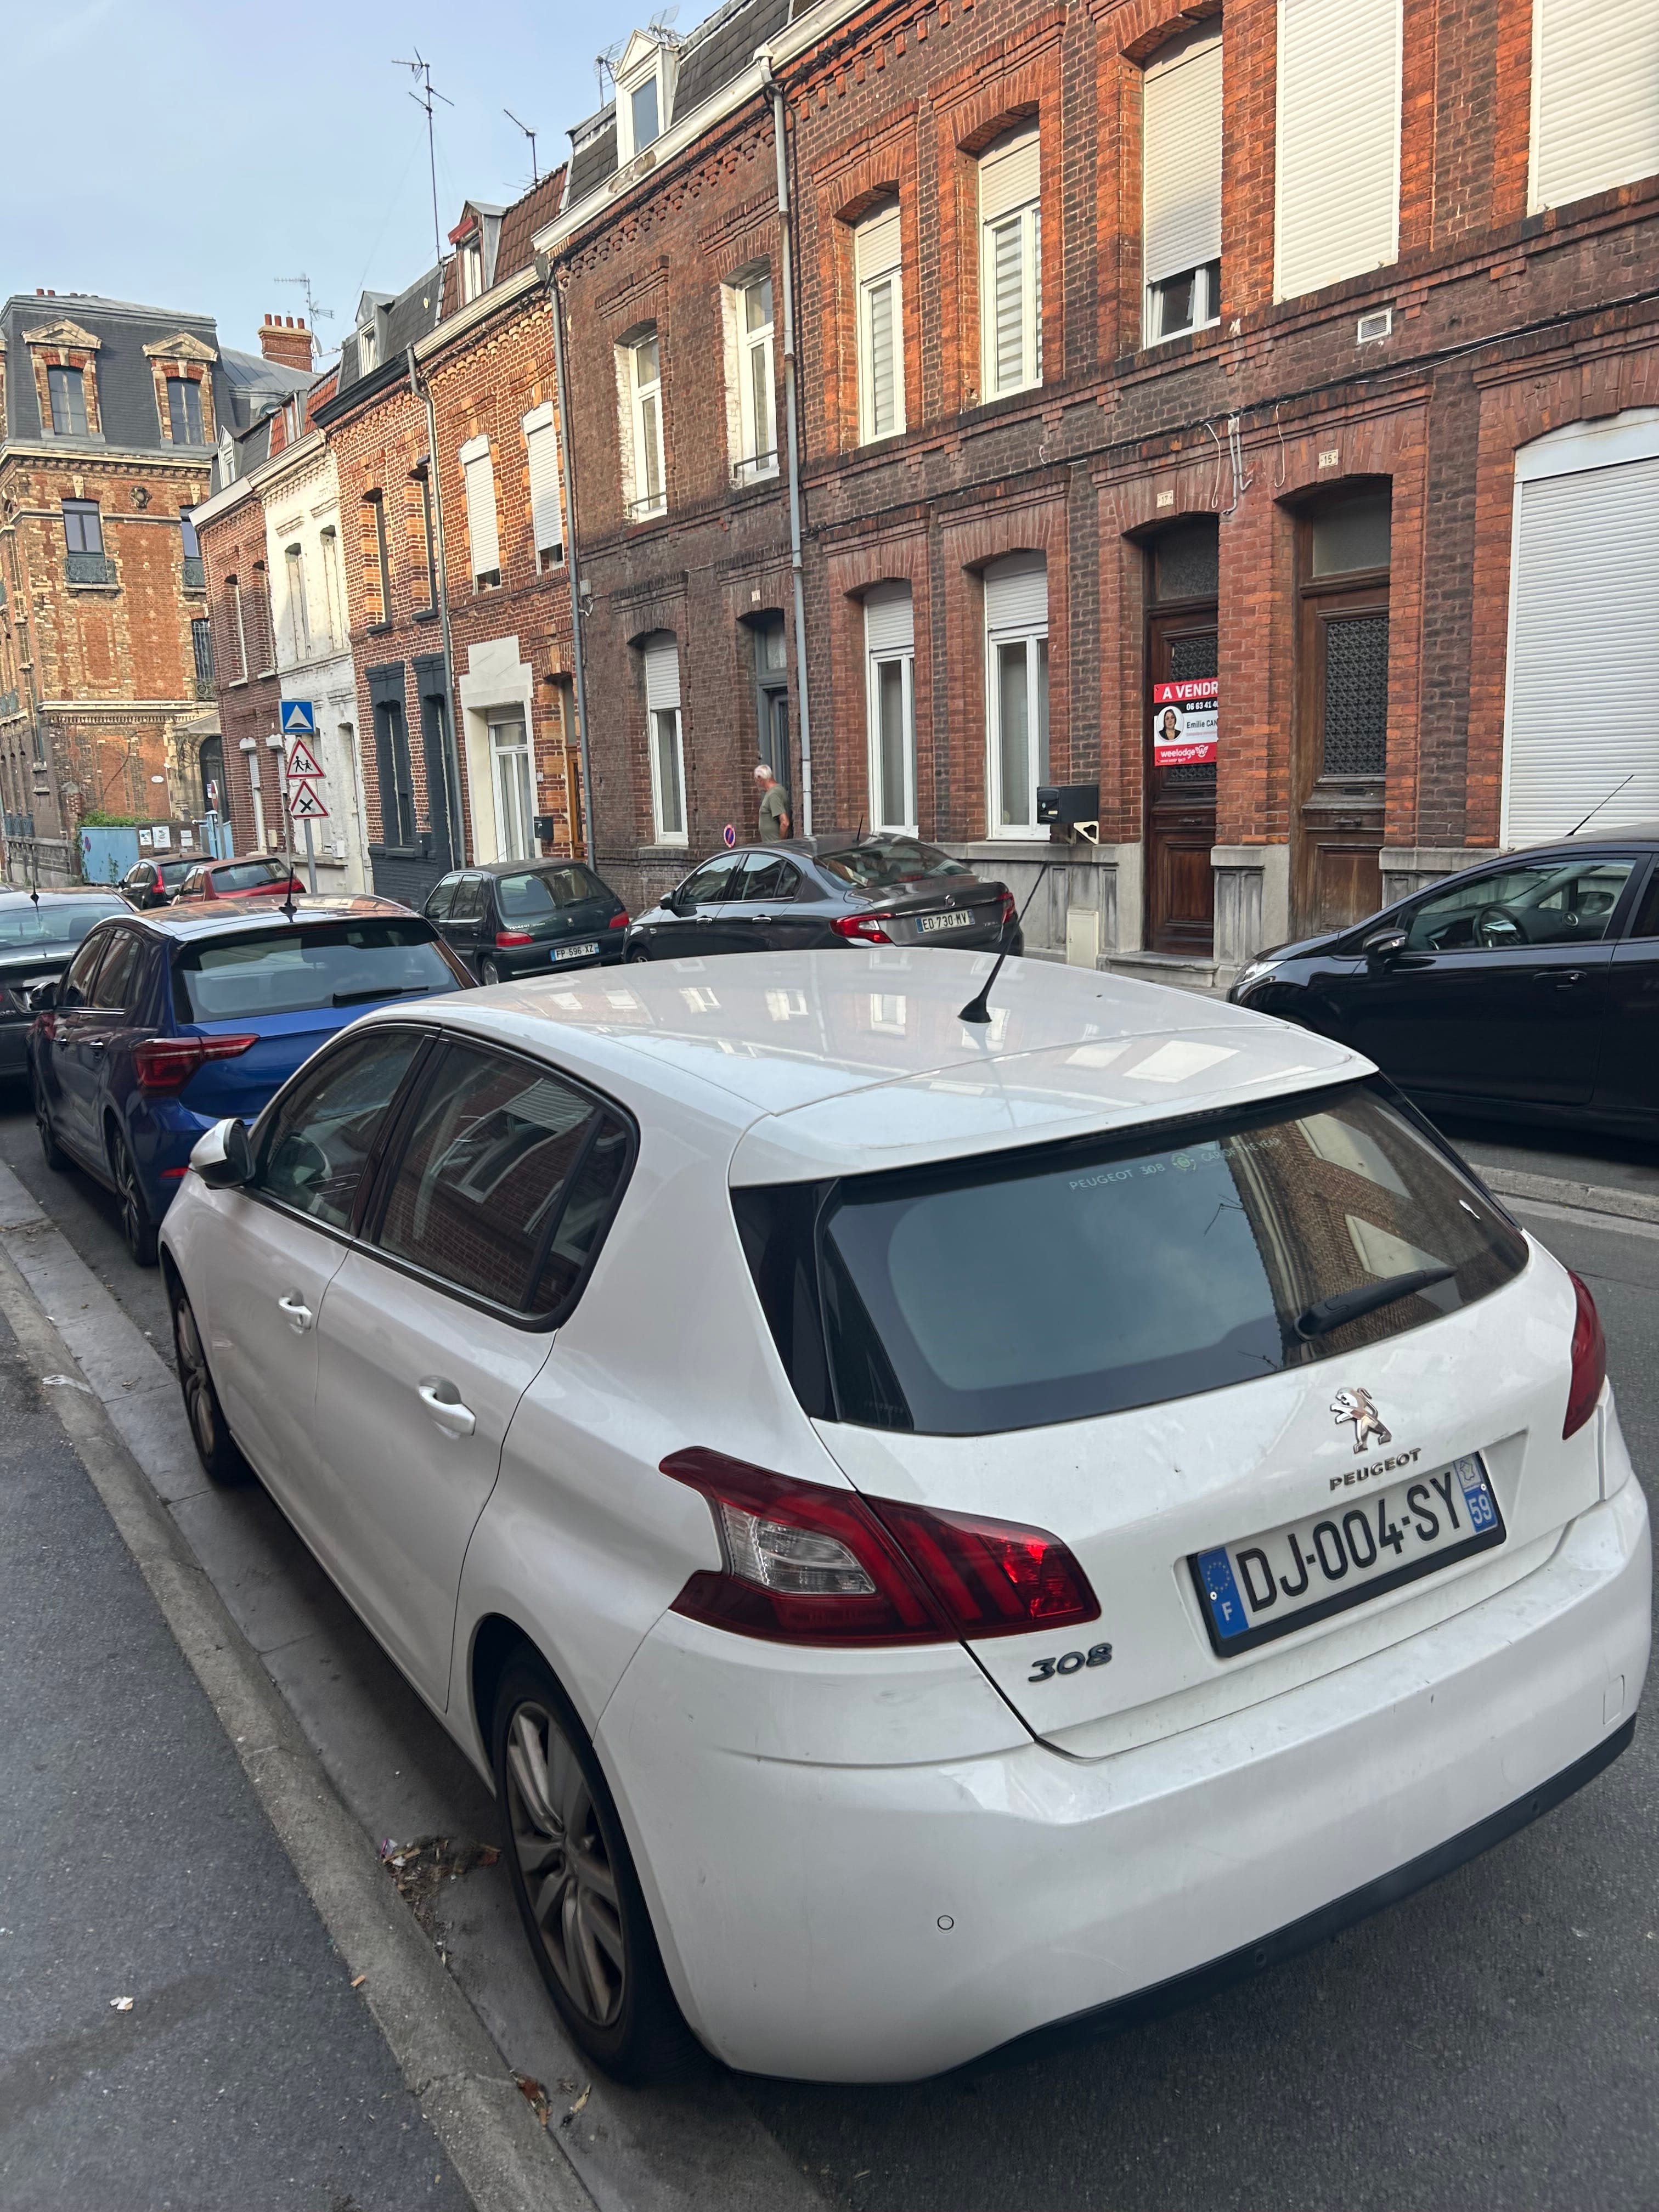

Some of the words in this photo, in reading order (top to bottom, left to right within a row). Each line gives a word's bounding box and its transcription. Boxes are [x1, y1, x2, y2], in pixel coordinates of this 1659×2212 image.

[1324, 454, 1332, 465] 15
[1161, 495, 1168, 504] 17
[1162, 686, 1172, 700] A
[1186, 703, 1194, 711] 06
[1195, 702, 1203, 710] 63
[1204, 701, 1212, 709] 41
[1187, 720, 1205, 729] Emilie
[1160, 748, 1195, 759] weelodge
[1070, 1169, 1133, 1190] PEUGEOT
[1139, 1163, 1166, 1176] 308
[1329, 1447, 1422, 1491] PEUGEOT
[1221, 1601, 1234, 1622] F
[1235, 1471, 1460, 1613] DJ-004-SY
[1468, 1494, 1493, 1526] 59
[1028, 1643, 1113, 1683] 308
